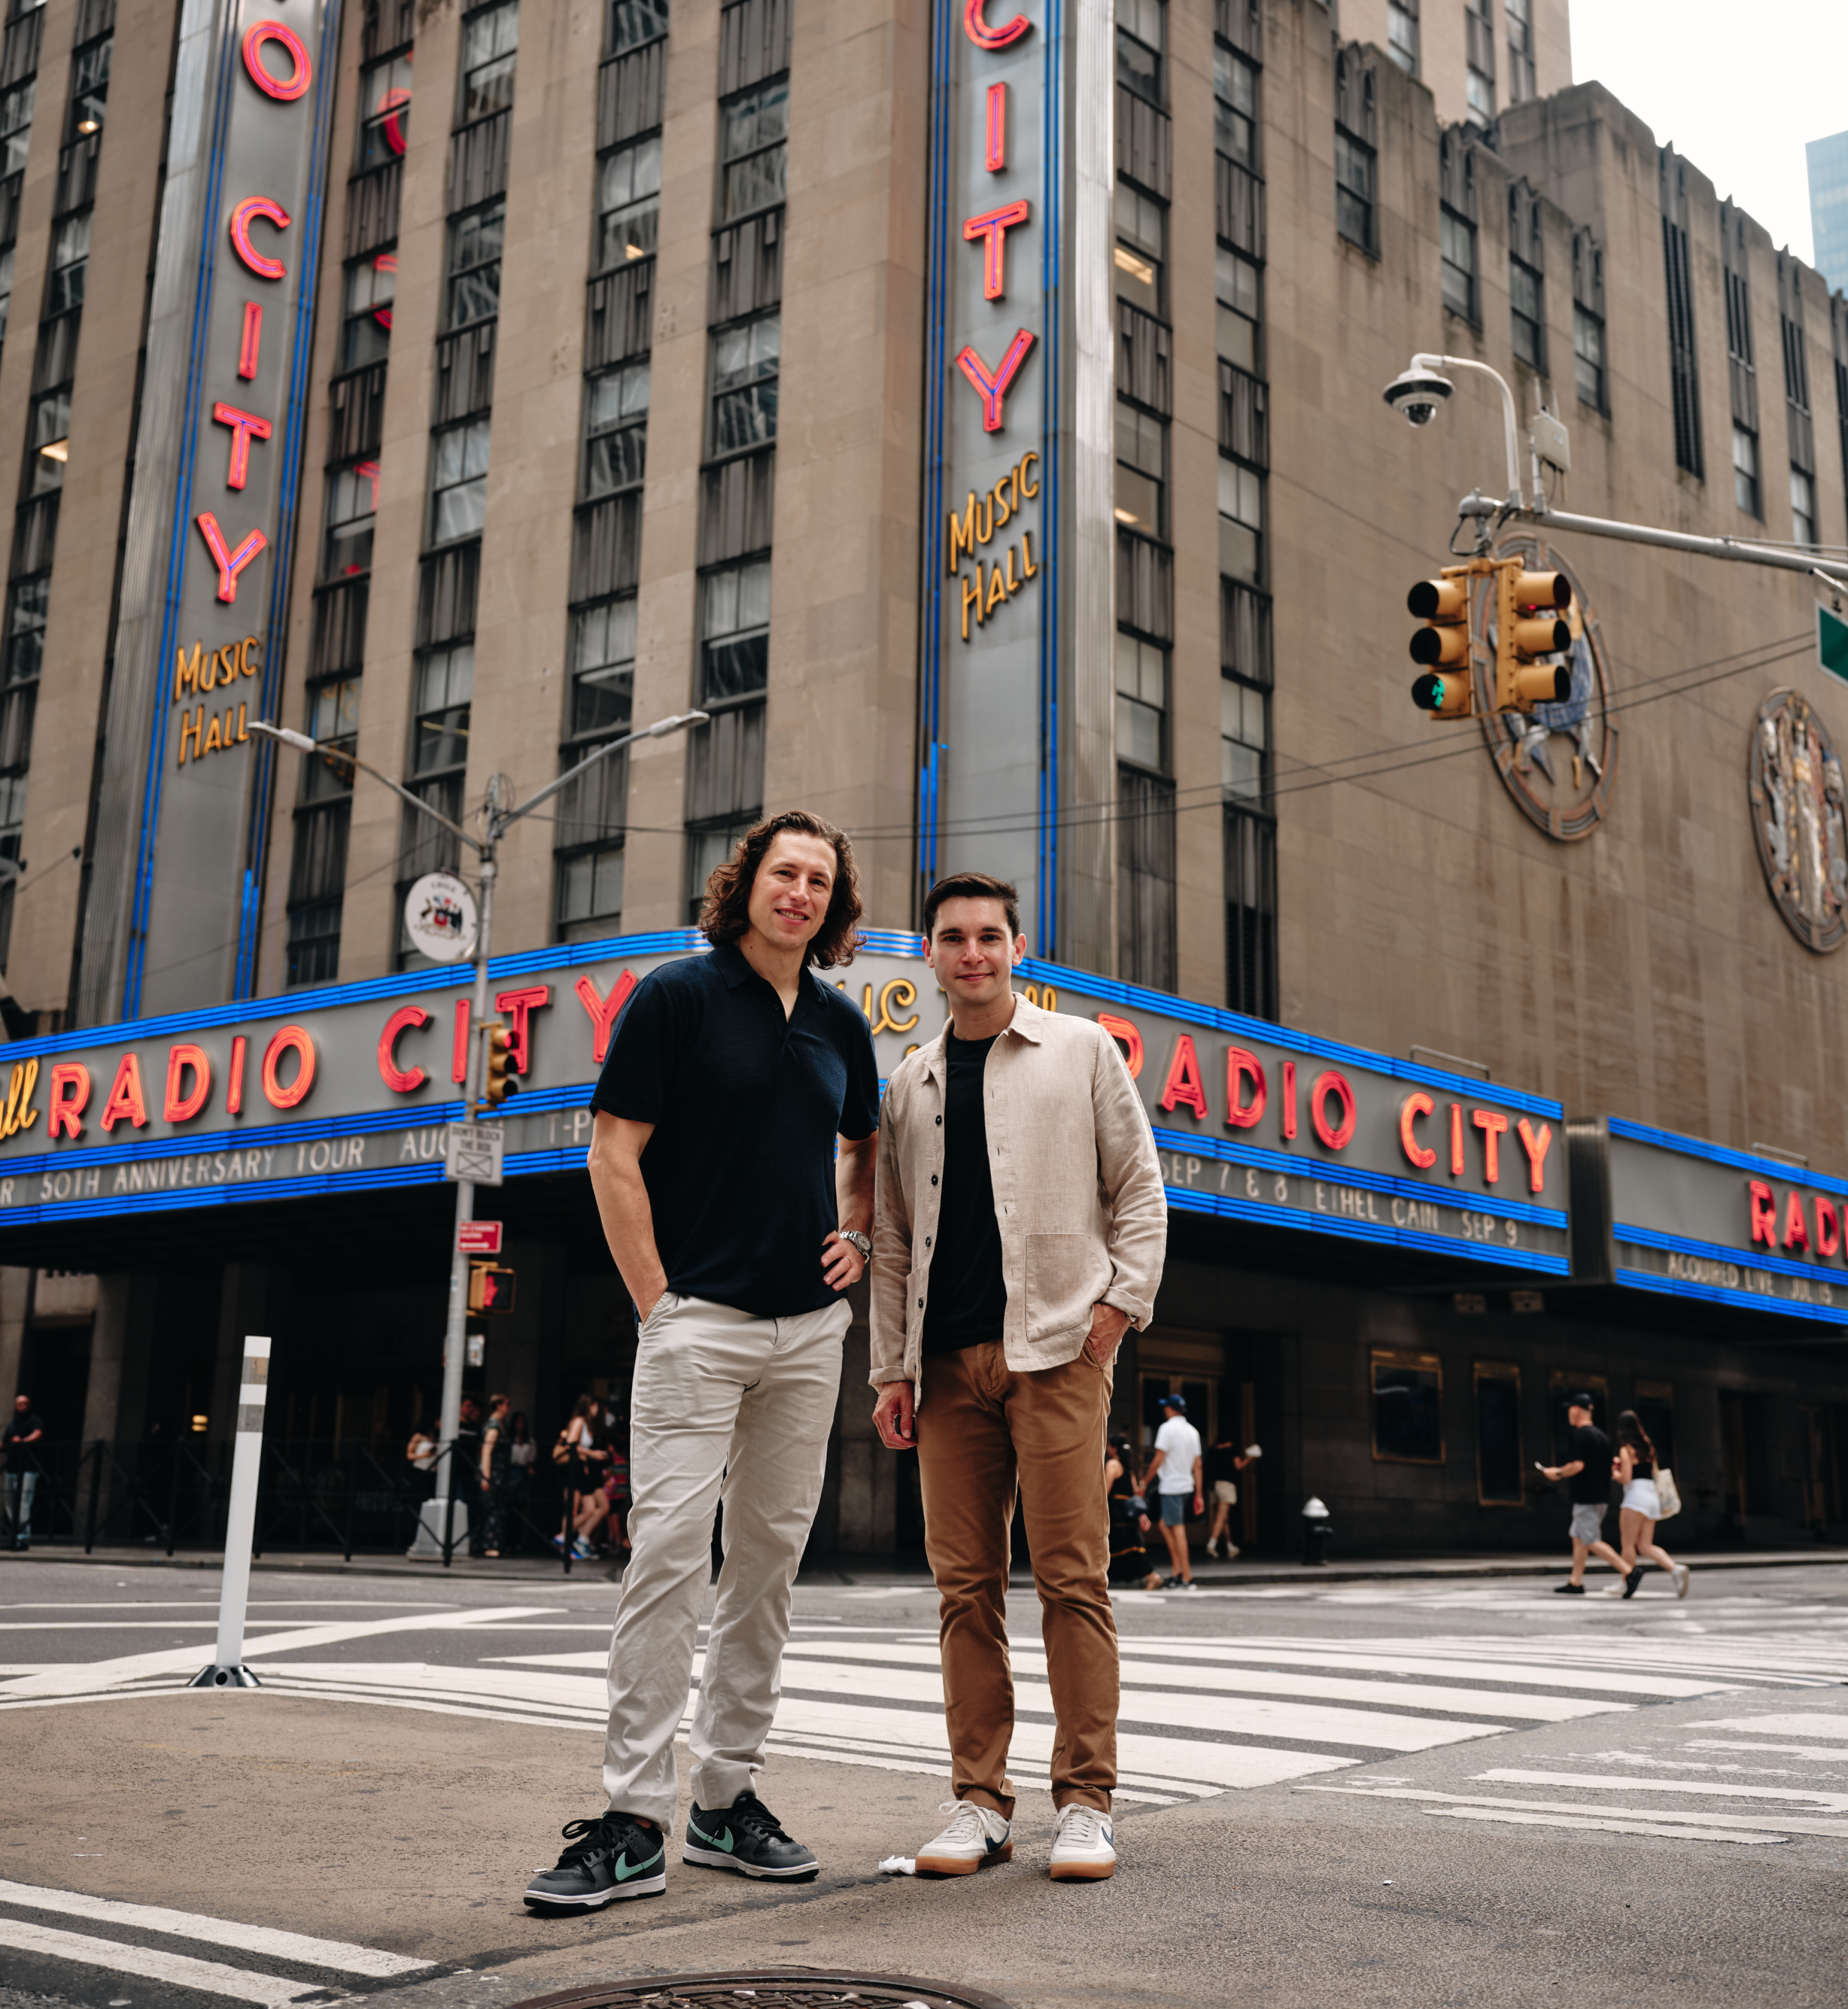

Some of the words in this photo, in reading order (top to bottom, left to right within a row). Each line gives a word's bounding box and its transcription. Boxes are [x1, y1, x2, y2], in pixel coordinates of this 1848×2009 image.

[198, 195, 292, 603] CITY
[950, 451, 1038, 573] MUSIC
[961, 531, 1037, 640] HALL
[175, 636, 258, 702] MUSIC
[179, 704, 250, 765] HALL
[0, 1058, 38, 1140] ll
[48, 1025, 316, 1140] RADIO
[377, 969, 637, 1092] CITY
[112, 1147, 276, 1194] ANNIVERSARY
[297, 1136, 365, 1172] TOUR
[1401, 1092, 1553, 1192] CITY
[1217, 1162, 1231, 1190] 7
[1274, 1175, 1288, 1202] 8
[1316, 1181, 1379, 1220] ETHEL
[1461, 1210, 1495, 1240] SEP
[1505, 1219, 1518, 1246] 9
